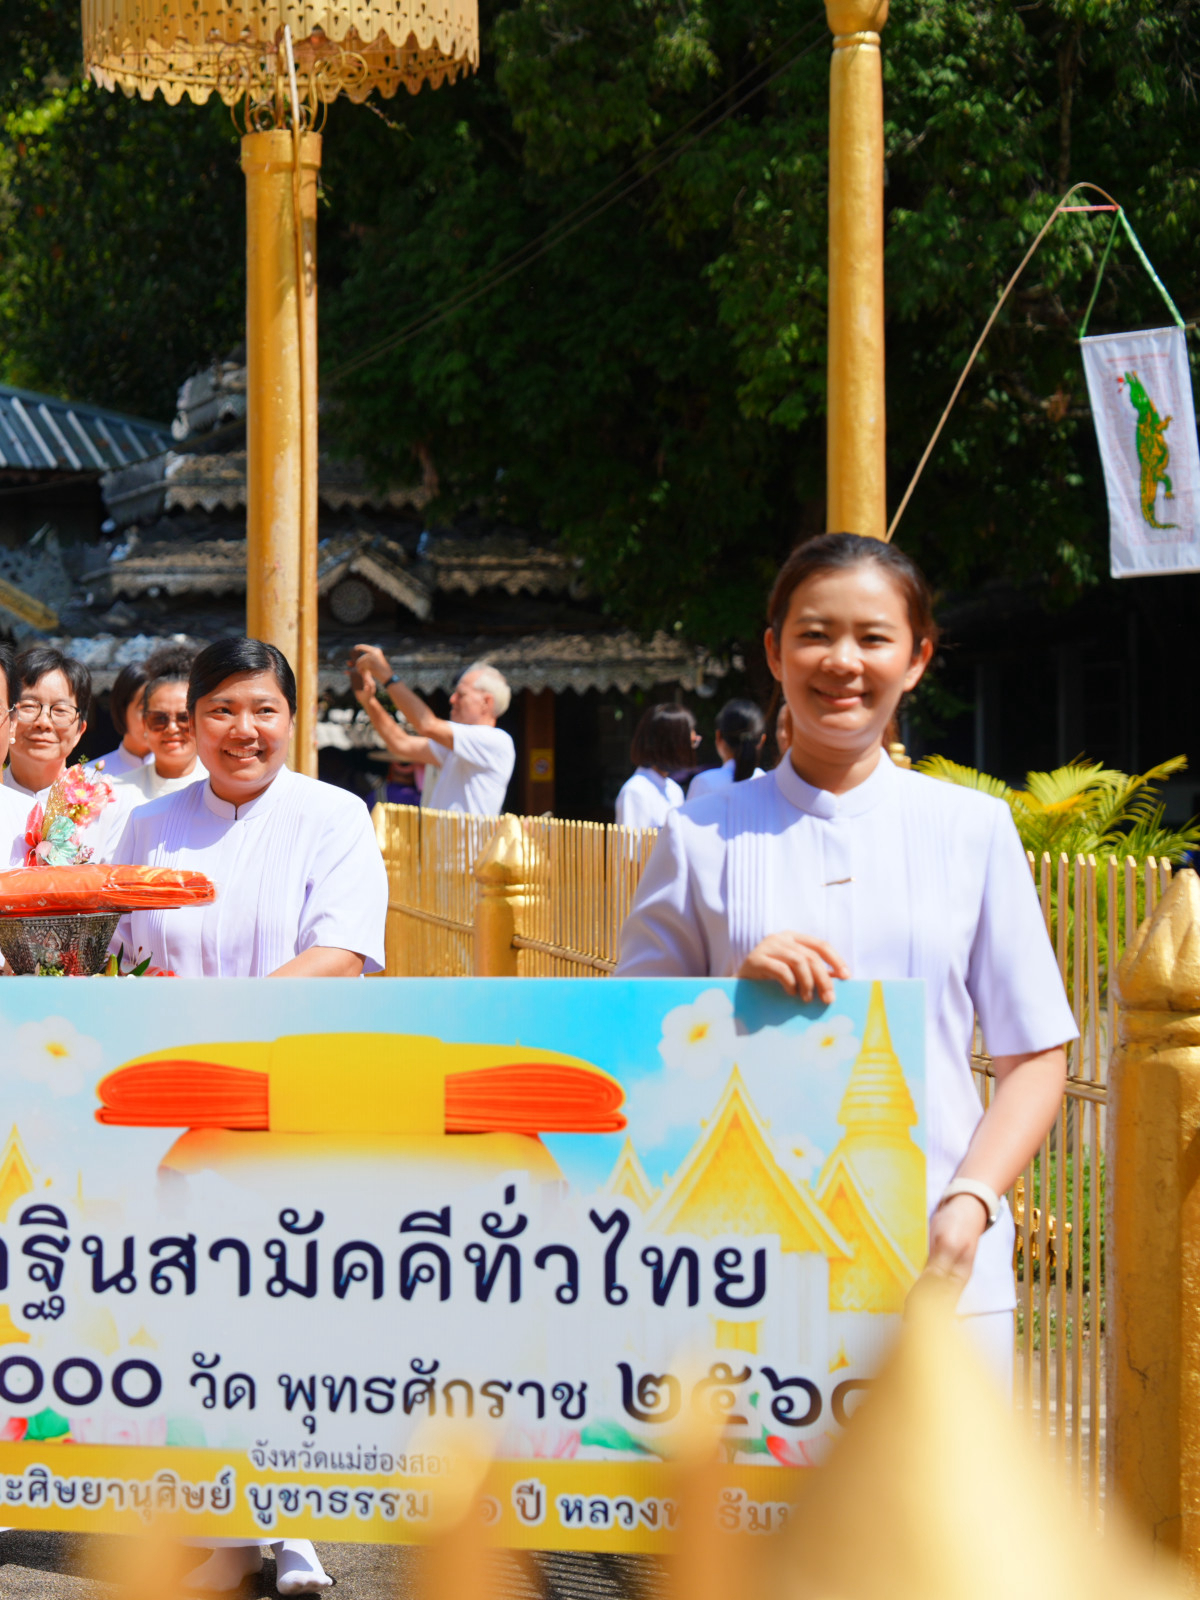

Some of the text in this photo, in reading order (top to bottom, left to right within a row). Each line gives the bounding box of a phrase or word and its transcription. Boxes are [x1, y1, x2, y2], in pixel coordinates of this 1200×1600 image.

[190, 1352, 257, 1410] วัด
[277, 1357, 588, 1435] พุทธศักราช
[249, 1486, 429, 1525] บูชาธรรม
[515, 1482, 541, 1521] ปี
